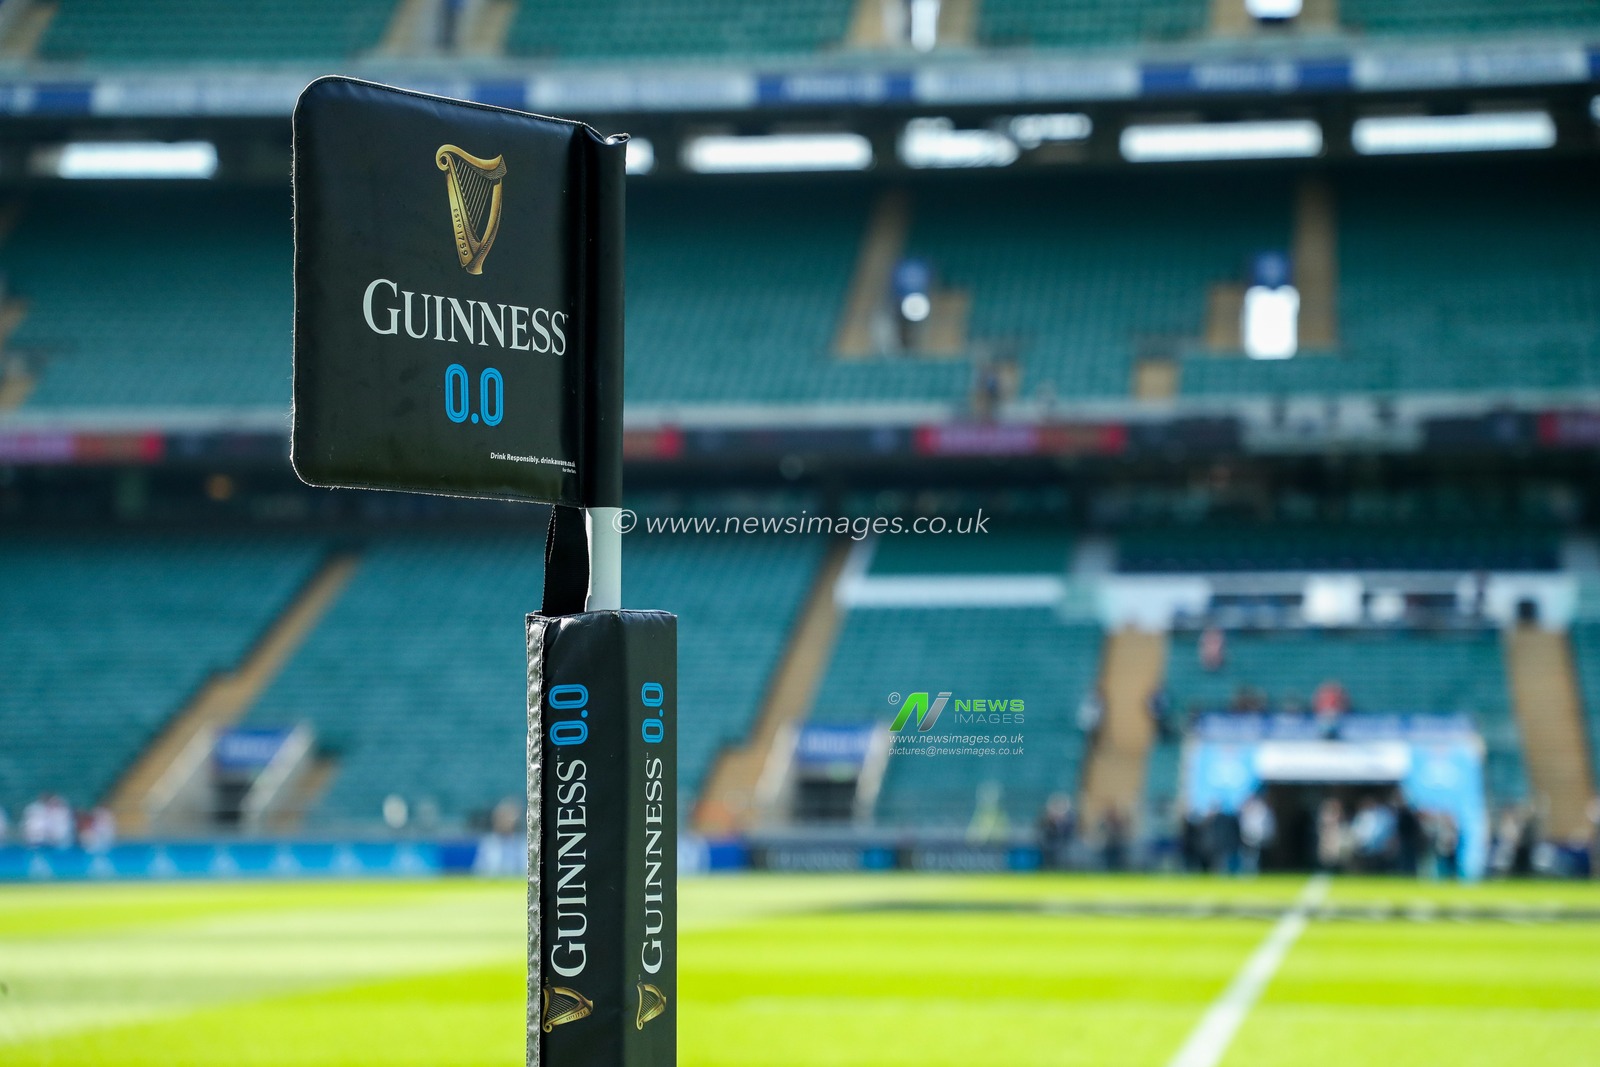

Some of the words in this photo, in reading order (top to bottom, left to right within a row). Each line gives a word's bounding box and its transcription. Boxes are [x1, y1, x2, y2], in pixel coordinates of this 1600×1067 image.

[456, 230, 468, 256] 1759
[362, 278, 568, 356] GUINNESS
[445, 363, 504, 427] 0.0
[490, 452, 506, 460] Drink
[506, 453, 540, 465] Responsibly.
[549, 683, 589, 746] 0.0
[641, 682, 664, 743] 0.0
[551, 757, 587, 977] GUINNESS
[641, 756, 663, 974] GUINNESS
